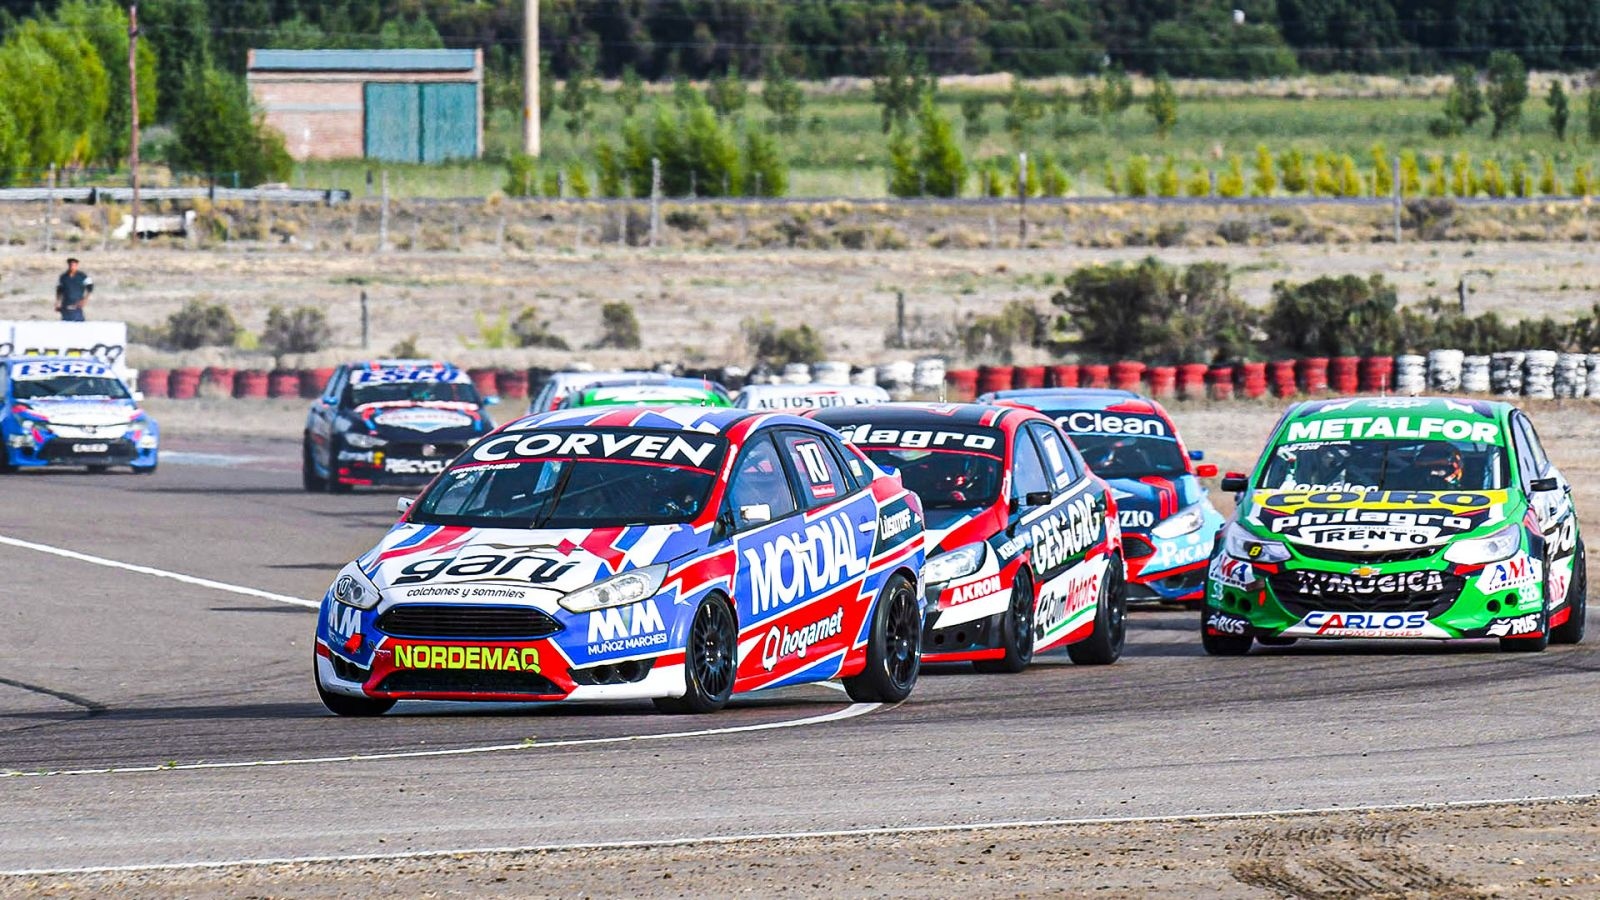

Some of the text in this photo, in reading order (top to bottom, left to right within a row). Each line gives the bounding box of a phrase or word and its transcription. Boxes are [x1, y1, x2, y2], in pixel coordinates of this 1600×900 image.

[360, 369, 459, 383] ESCO
[1287, 416, 1499, 443] METALFOR
[473, 433, 716, 467] CORVEN
[1265, 490, 1491, 507] COIRO
[1271, 508, 1472, 534] philagro
[1308, 527, 1429, 545] TRENTO
[744, 511, 867, 616] MONDIAL
[1249, 546, 1262, 556] 8
[392, 554, 581, 586] gani
[406, 586, 526, 599] colchones y sommiers
[951, 575, 1001, 606] AKRON
[588, 599, 666, 643] MM
[780, 606, 844, 659] hogarnet
[1217, 616, 1246, 635] RUS
[1303, 613, 1426, 635] CARLOS
[588, 634, 668, 655] MUÑOZ MARCHESI
[394, 645, 542, 675] NORDEMAQ
